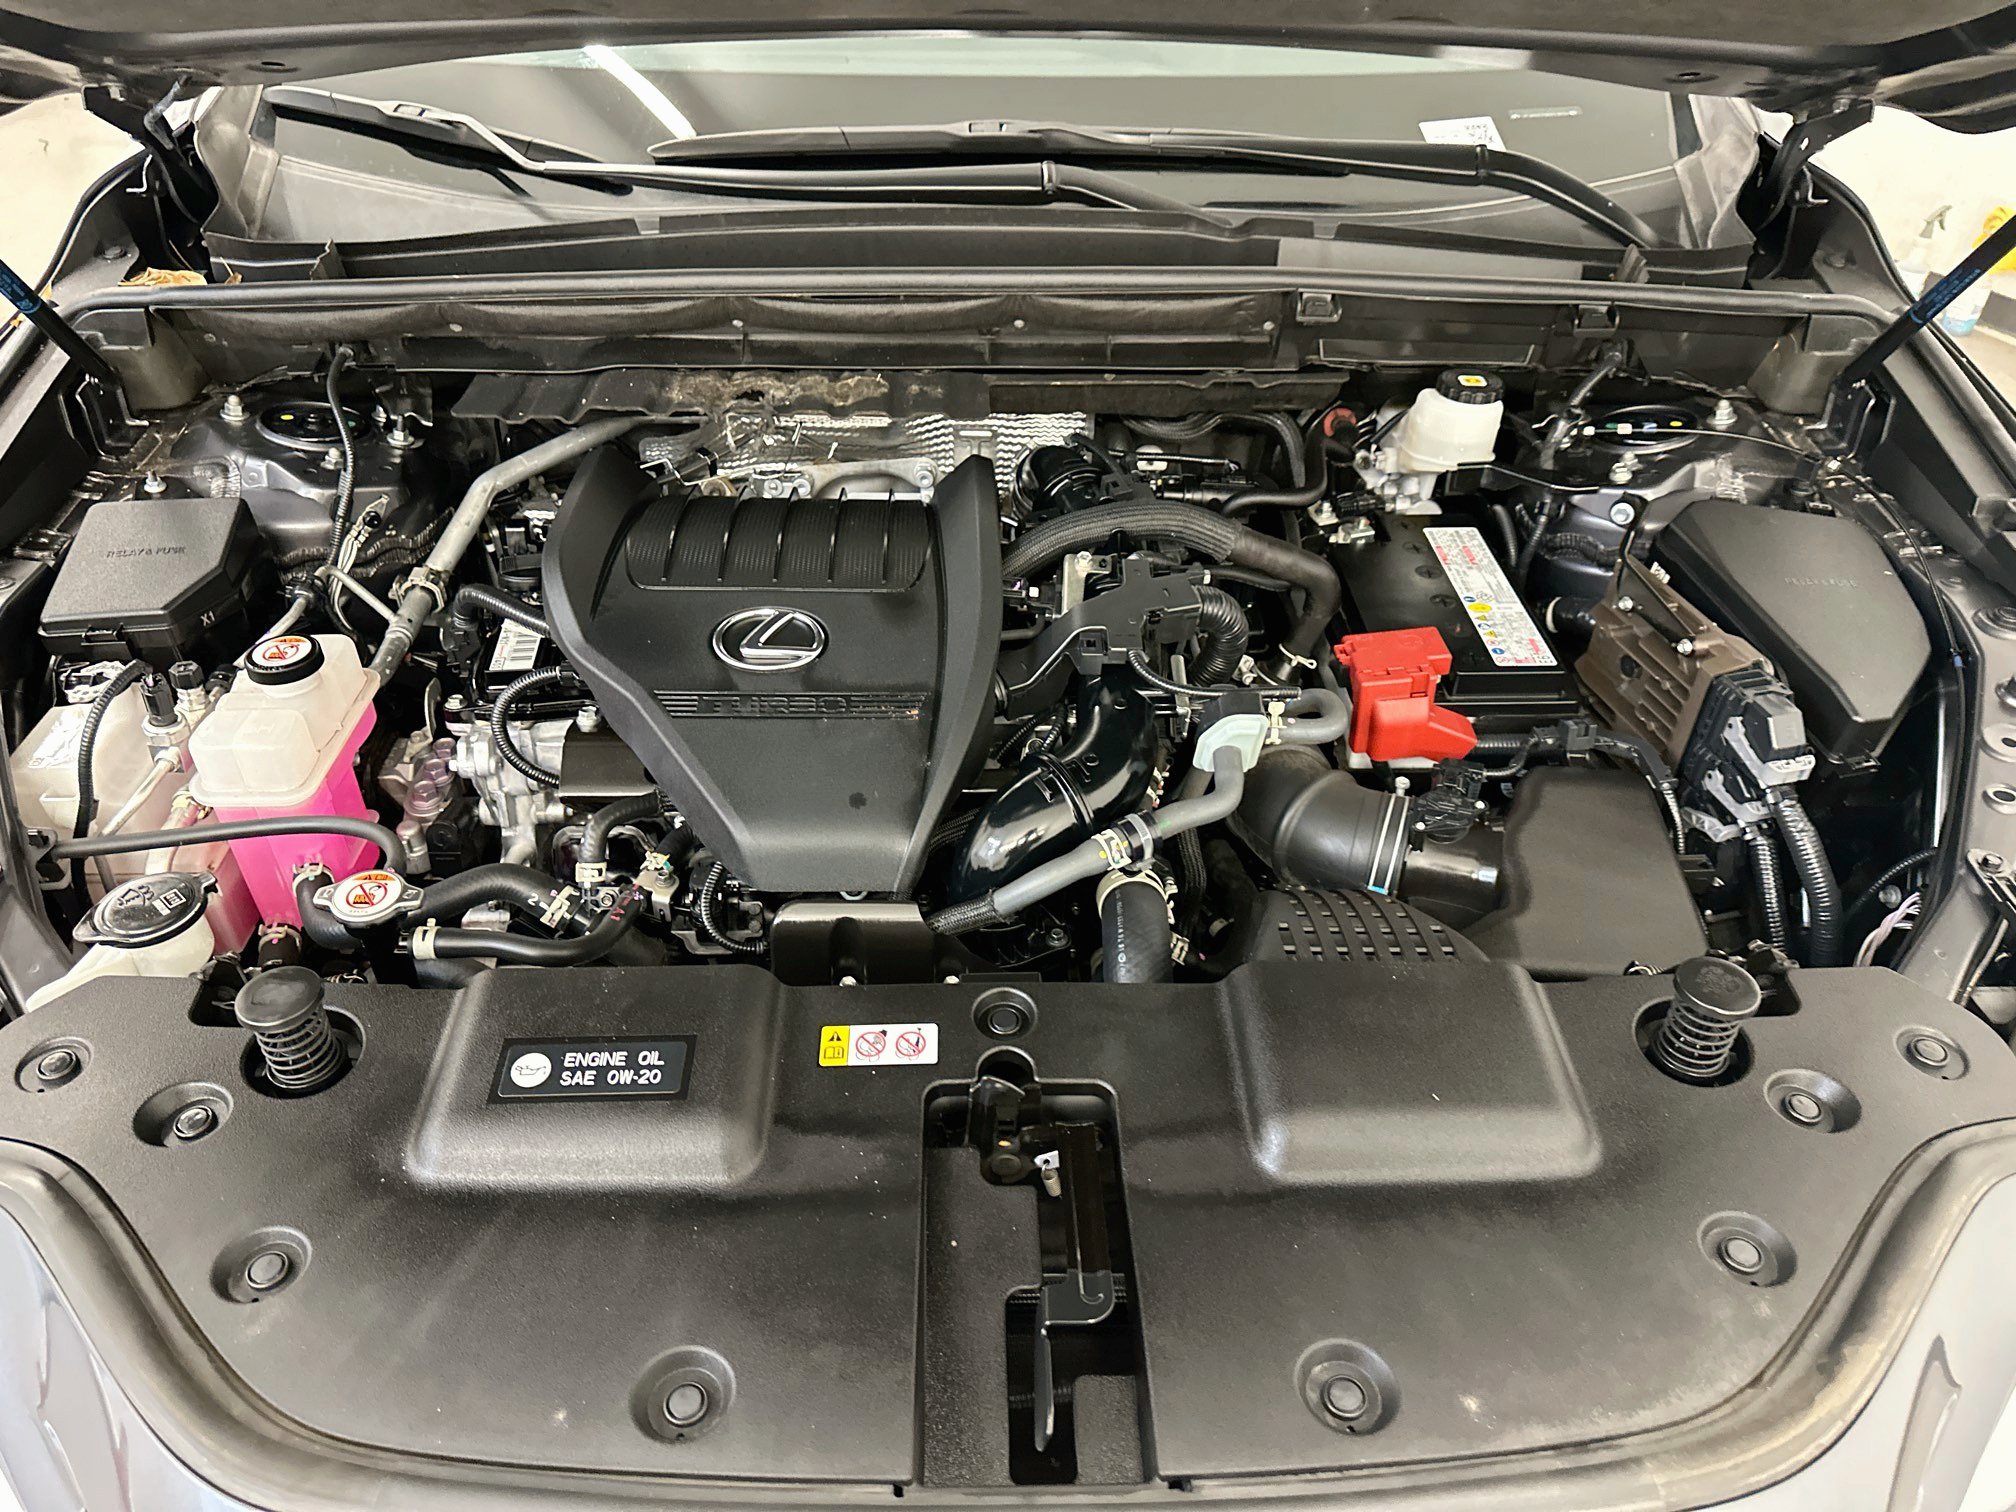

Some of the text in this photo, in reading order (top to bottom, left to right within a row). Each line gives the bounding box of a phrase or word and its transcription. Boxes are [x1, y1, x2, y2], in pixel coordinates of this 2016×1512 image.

[200, 610, 216, 627] X1
[702, 696, 847, 714] TURBO
[563, 1050, 665, 1068] ENGINE OIL
[560, 1069, 662, 1086] SAE 0W-20
